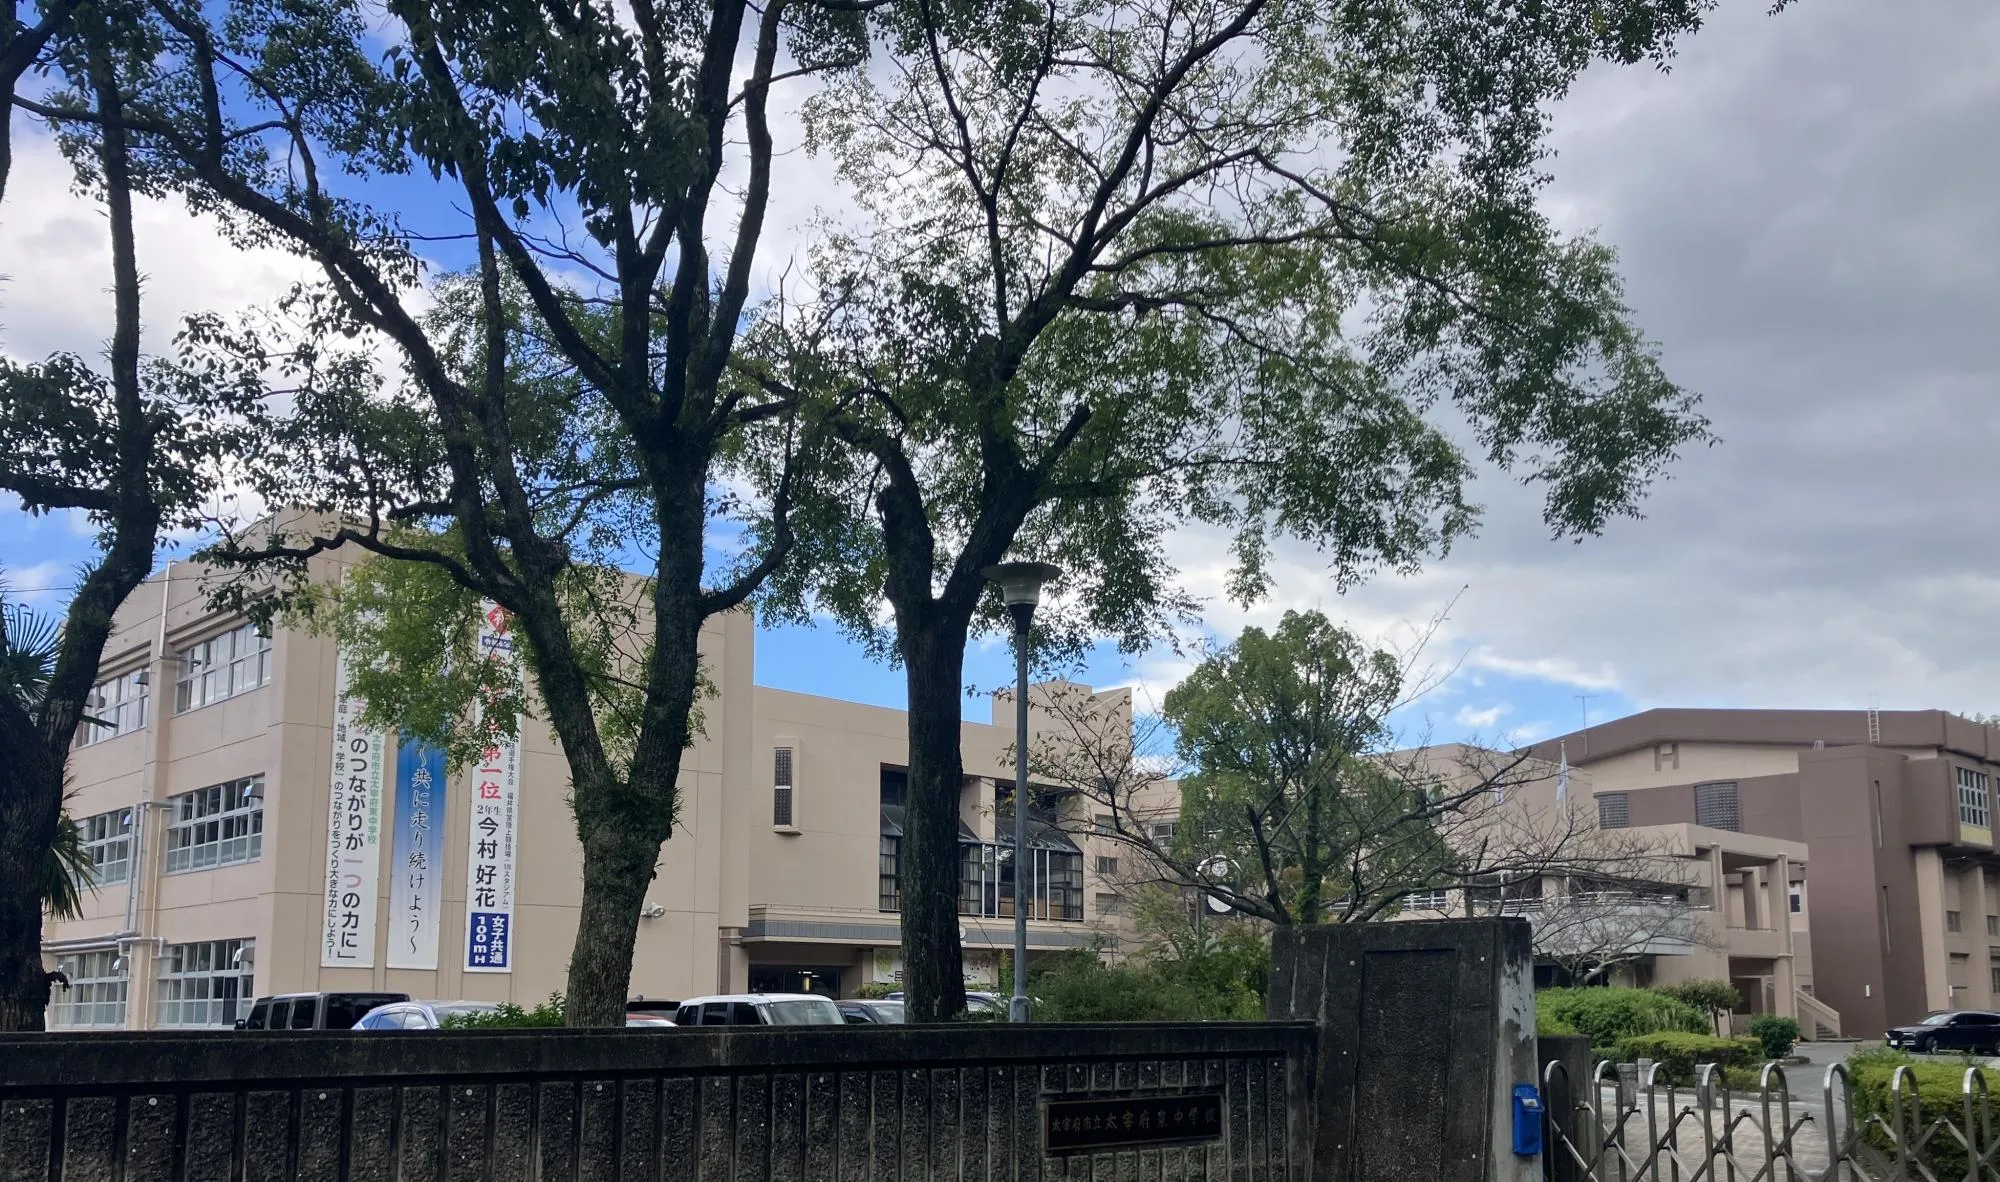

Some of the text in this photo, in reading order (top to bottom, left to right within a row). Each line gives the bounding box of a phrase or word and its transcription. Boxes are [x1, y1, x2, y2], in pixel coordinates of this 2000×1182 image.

[477, 804, 501, 815] 2年生
[475, 817, 499, 908] 今村好花
[473, 916, 487, 964] 100mH
[489, 916, 505, 964] 女子共通
